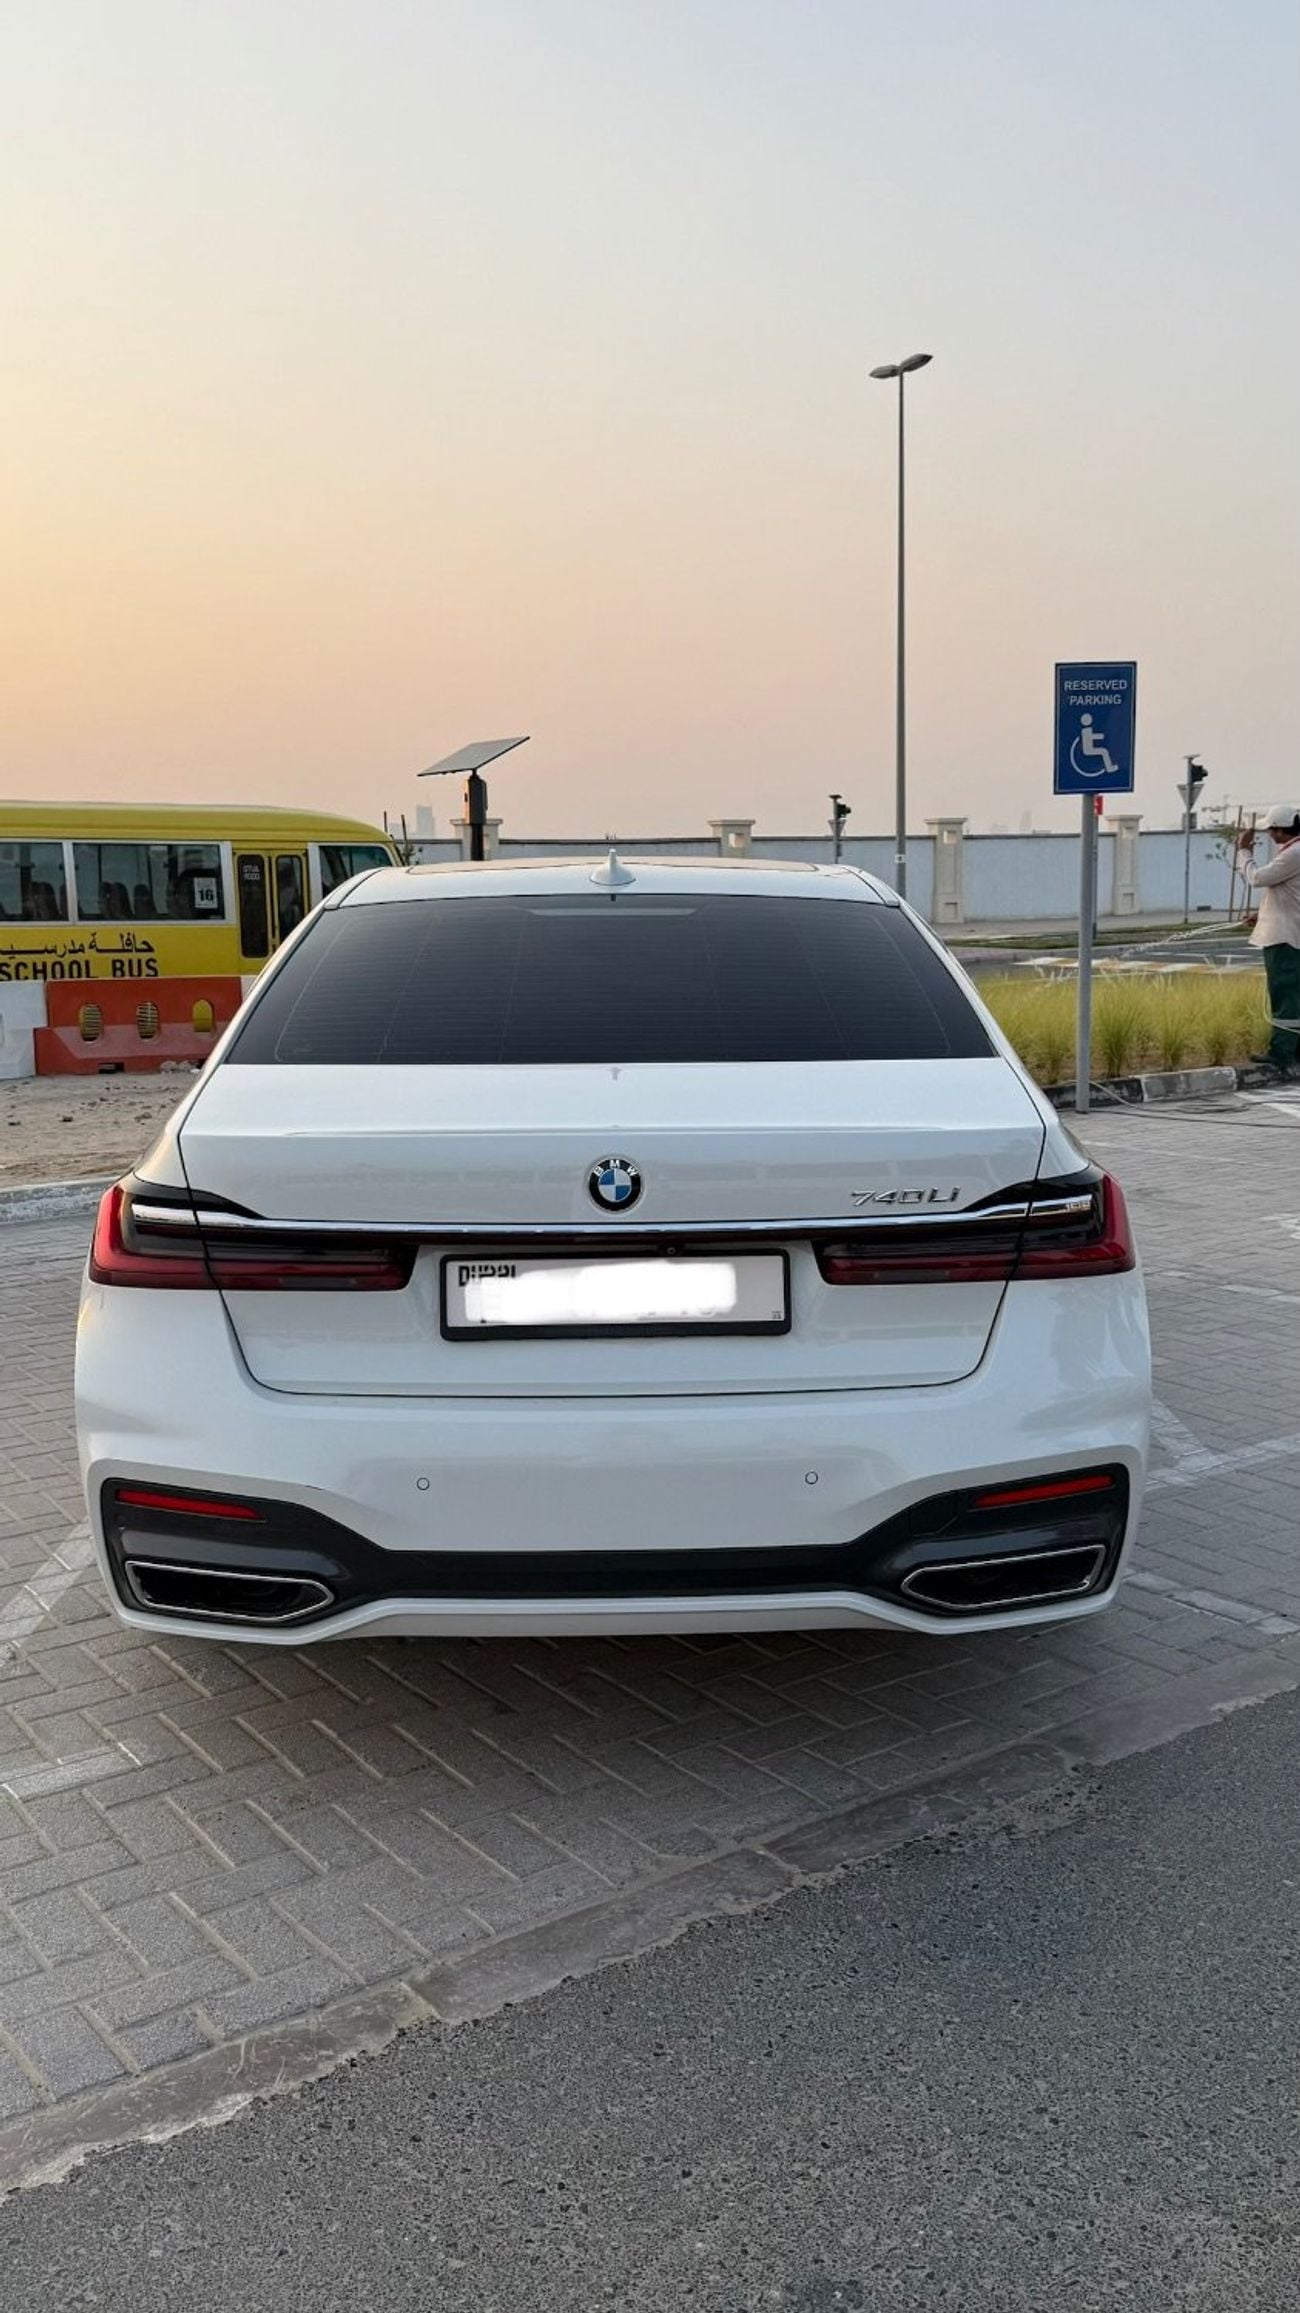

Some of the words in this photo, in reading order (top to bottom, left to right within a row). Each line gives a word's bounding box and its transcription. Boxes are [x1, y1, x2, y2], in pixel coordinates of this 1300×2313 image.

[1064, 680, 1127, 691] RESERVED
[1069, 694, 1122, 706] PARKING
[198, 889, 214, 902] 16
[88, 932, 155, 953] حافلة
[0, 959, 98, 981] SCHOOL
[112, 958, 159, 978] BUS
[593, 1159, 640, 1177] BMW
